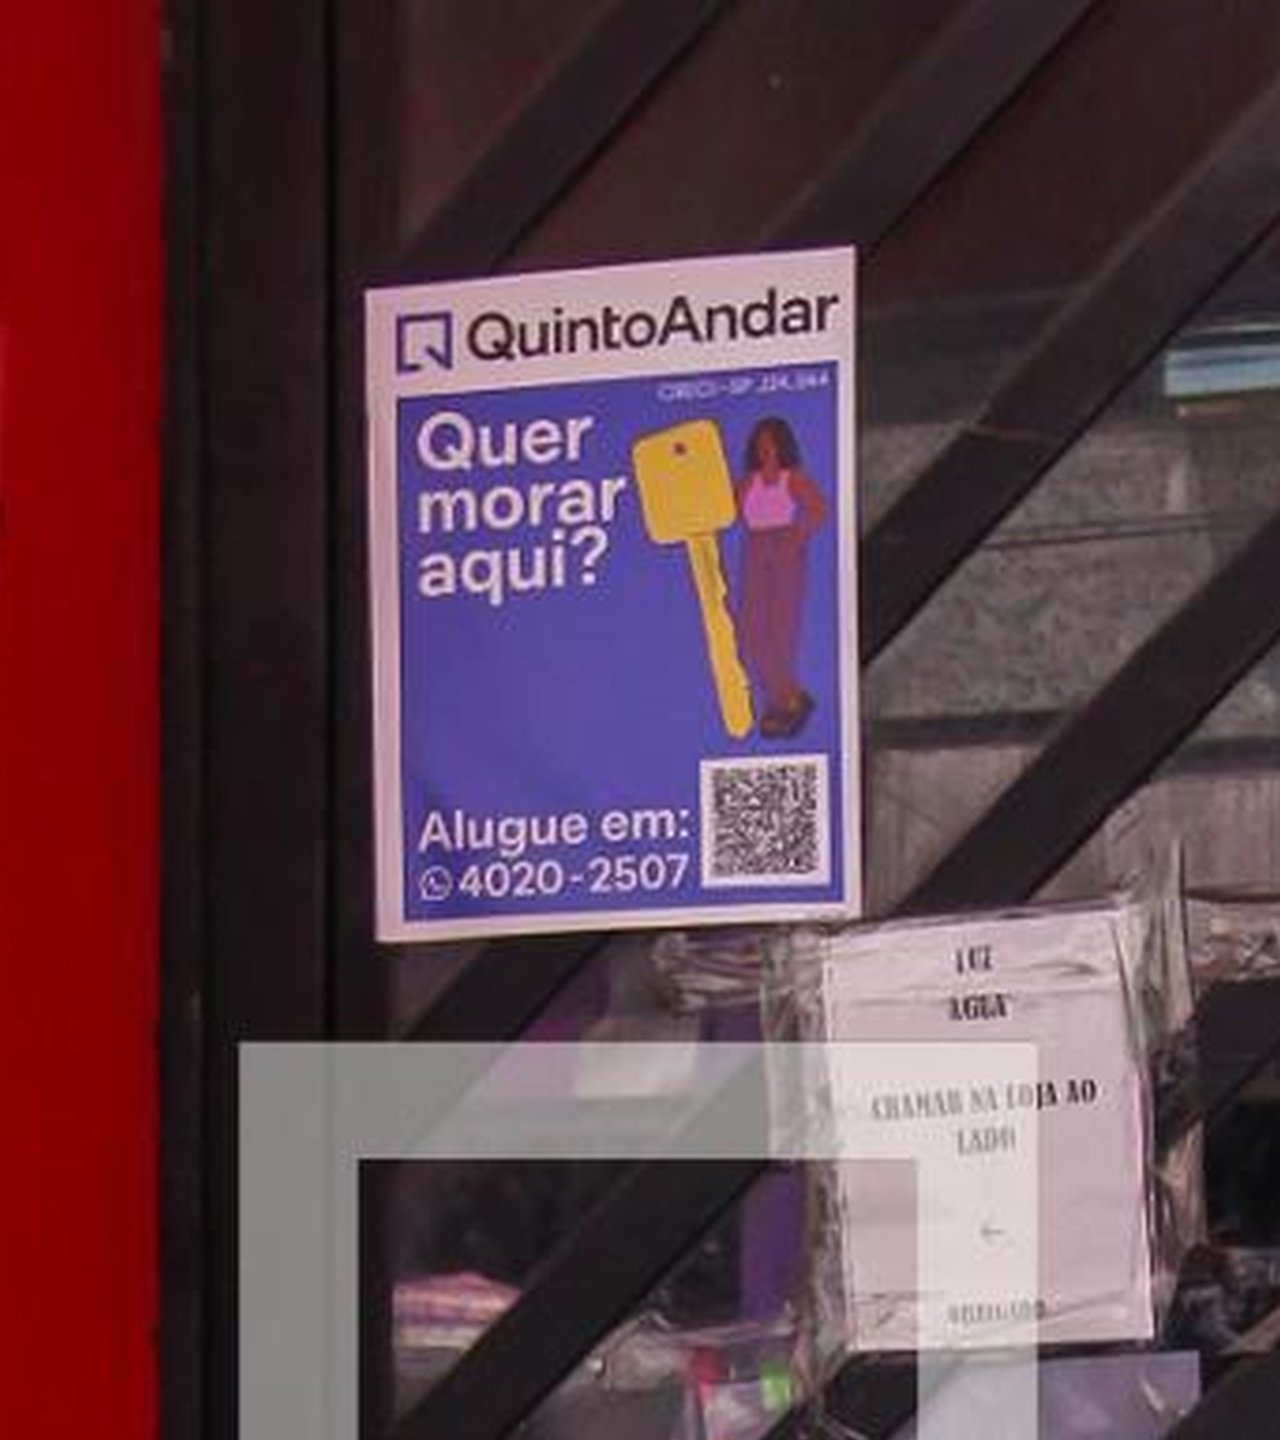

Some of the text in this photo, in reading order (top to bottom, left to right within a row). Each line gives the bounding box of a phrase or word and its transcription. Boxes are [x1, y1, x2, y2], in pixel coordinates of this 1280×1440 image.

[466, 288, 839, 362] QuintoAndar
[417, 411, 594, 472] Quer
[419, 476, 626, 534] morar
[419, 526, 609, 607] aqui?
[419, 808, 691, 859] Alugue em:
[969, 1083, 999, 1112] NA
[1006, 1080, 1058, 1111] LOJA
[1066, 1078, 1098, 1105] AO
